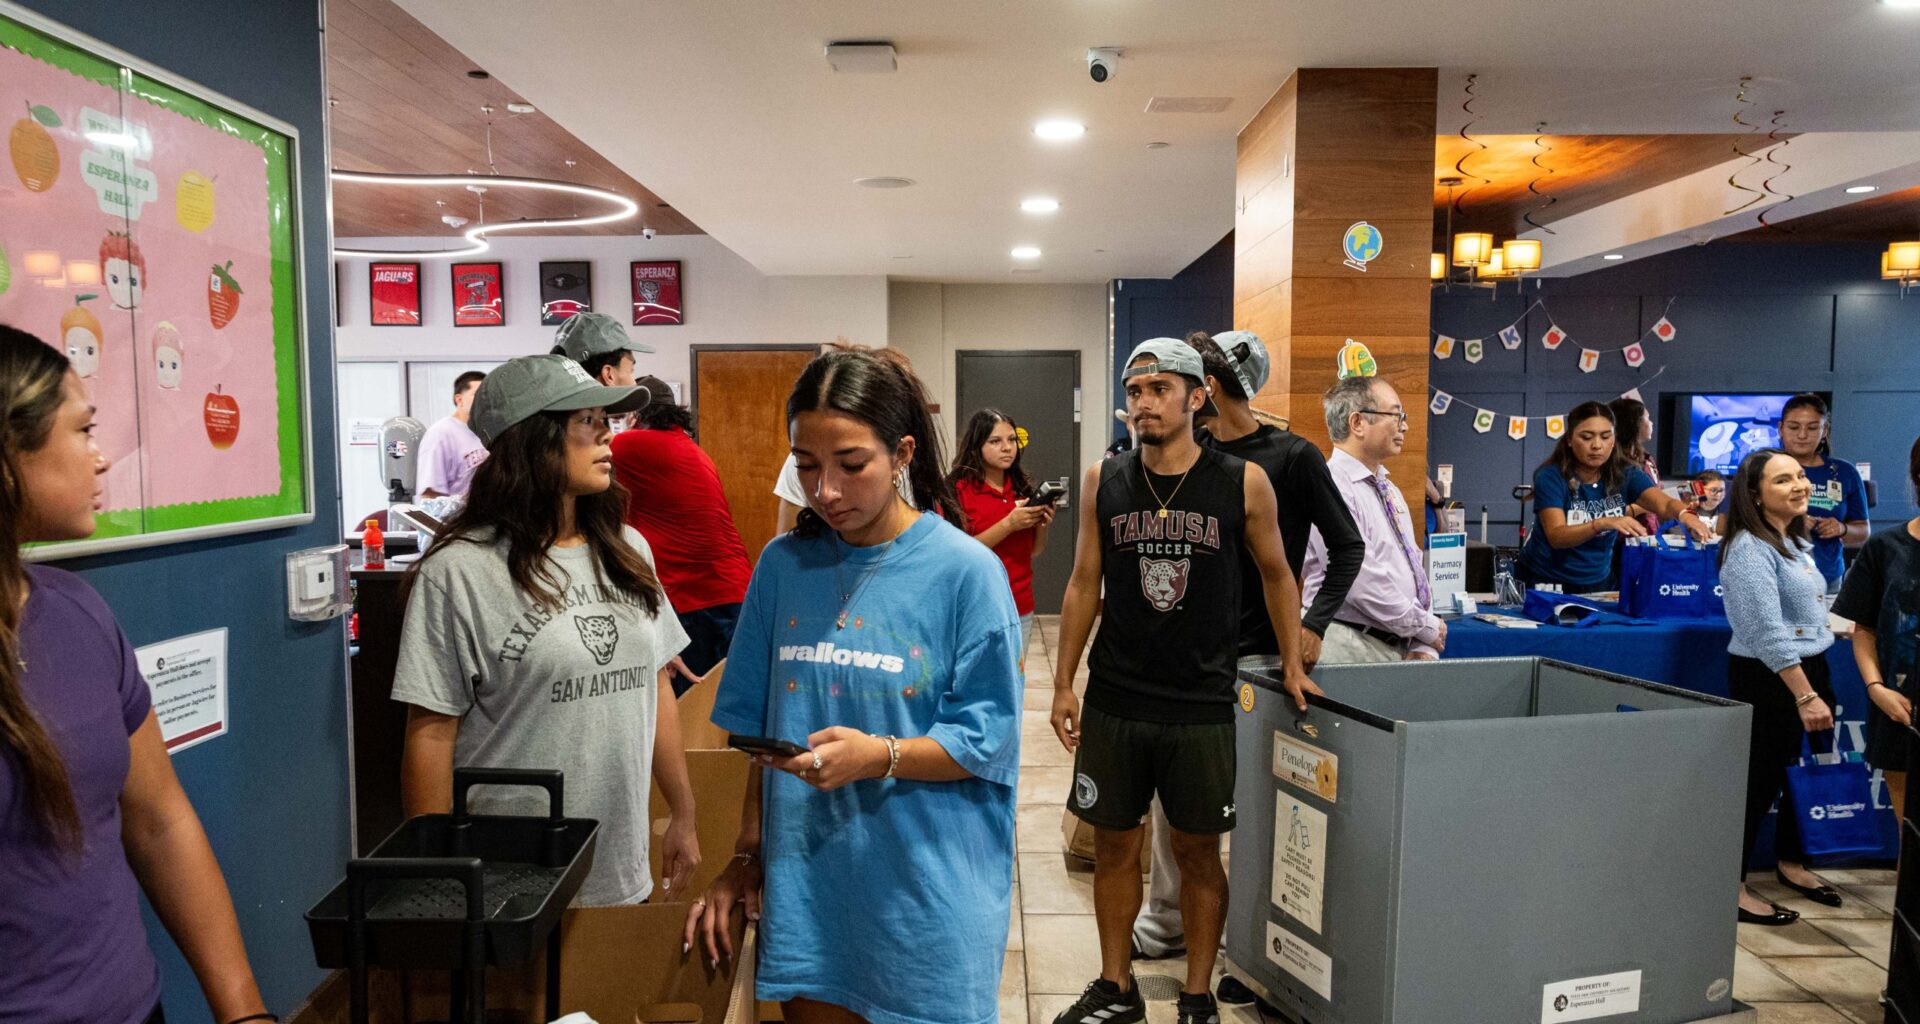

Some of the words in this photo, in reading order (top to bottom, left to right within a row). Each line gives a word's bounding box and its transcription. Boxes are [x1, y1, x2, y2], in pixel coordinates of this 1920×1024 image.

[87, 162, 149, 191] ESPERANZA
[374, 271, 414, 283] JAGUARS
[635, 267, 677, 278] ESPERANZA
[1436, 324, 1521, 357] ACK
[1583, 347, 1642, 368] TO
[1433, 394, 1563, 434] SCHO
[1584, 506, 1624, 523] AKER
[1110, 510, 1220, 549] TAMUSA
[1137, 543, 1192, 555] SOCCER
[1433, 560, 1463, 569] Pharmacy
[1435, 572, 1459, 581] Services
[1672, 584, 1699, 592] University
[498, 602, 553, 663] TEXAS
[780, 642, 904, 673] wallows
[551, 676, 585, 703] SAN
[588, 666, 647, 697] ANTONIO
[1244, 689, 1250, 705] 2
[1282, 747, 1318, 776] Penelope
[1826, 802, 1866, 812] University
[1285, 845, 1296, 856] CART
[1296, 850, 1307, 861] MUST
[1286, 852, 1301, 866] PUSHED
[1302, 861, 1310, 870] FOR
[1281, 857, 1295, 869] SAFETY
[1284, 879, 1295, 890] CART
[1295, 885, 1310, 899] BEHIND
[1292, 876, 1301, 886] NOT
[1301, 882, 1311, 893] PULL
[1285, 938, 1303, 953] PROPERTY
[1575, 983, 1602, 991] PROPERTY
[1570, 999, 1595, 1008] Esperanza
